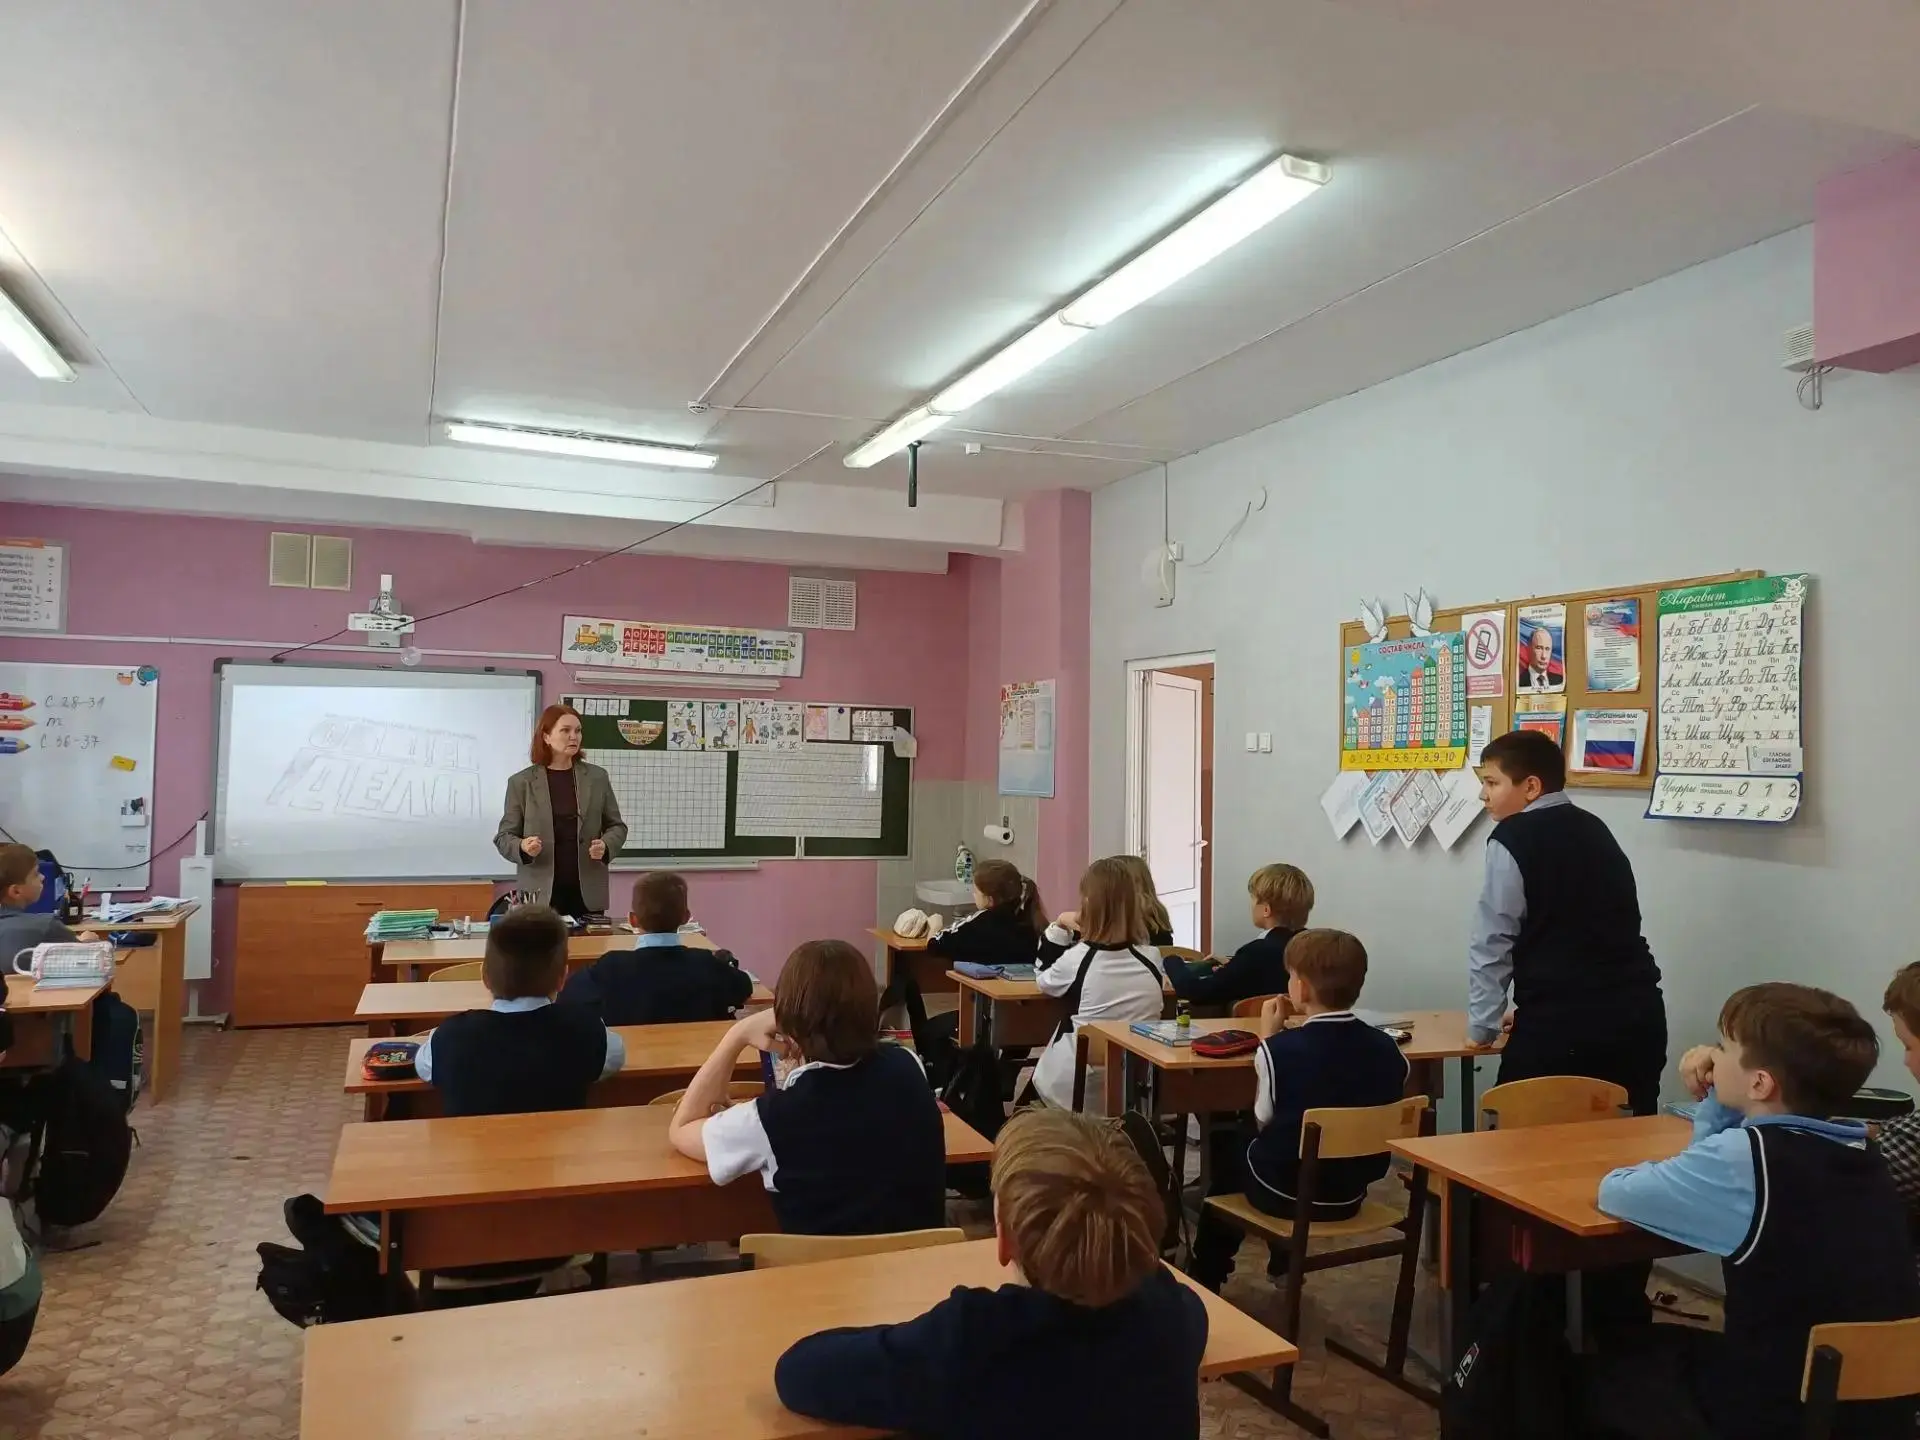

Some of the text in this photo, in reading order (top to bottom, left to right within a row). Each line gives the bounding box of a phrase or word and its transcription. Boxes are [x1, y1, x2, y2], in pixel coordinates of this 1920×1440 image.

[1659, 588, 1727, 610] Алфавит
[1378, 641, 1426, 654] СОСТАВ ЧИСЛА
[1662, 779, 1697, 800] Цифры
[1737, 781, 1750, 797] 0
[1788, 783, 1798, 798] 2
[1655, 800, 1665, 812] 3
[1694, 801, 1706, 813] 5
